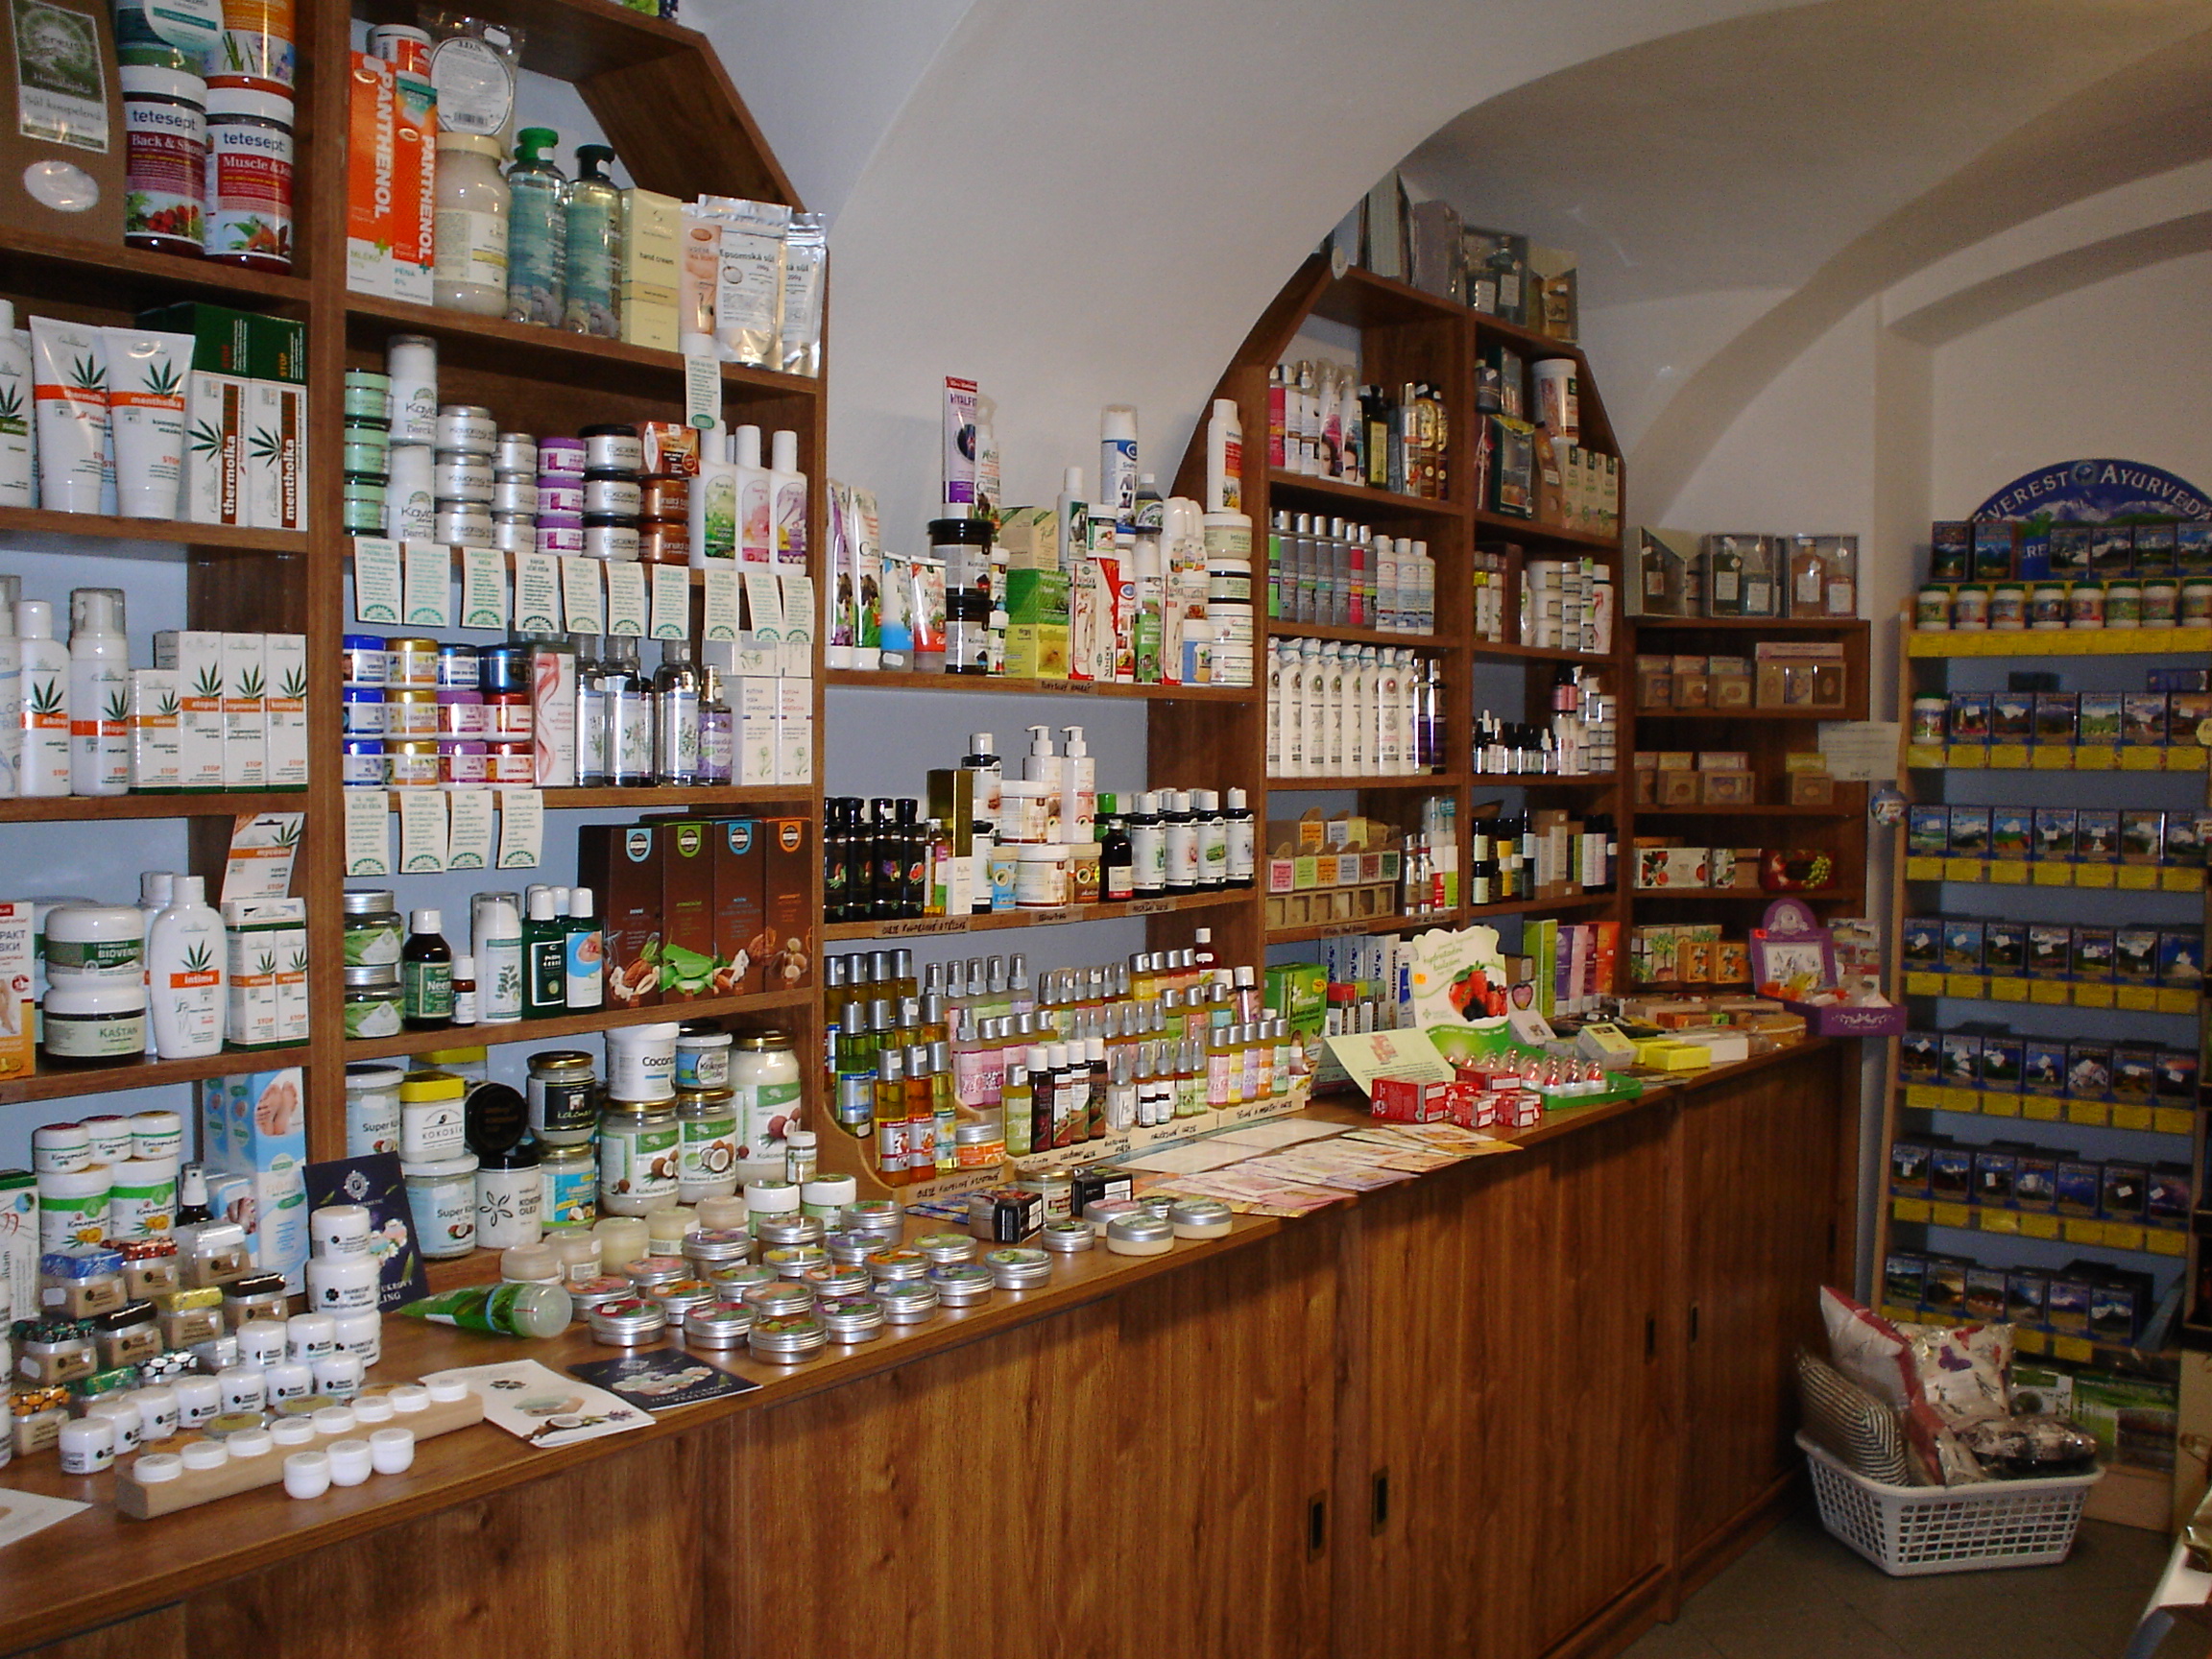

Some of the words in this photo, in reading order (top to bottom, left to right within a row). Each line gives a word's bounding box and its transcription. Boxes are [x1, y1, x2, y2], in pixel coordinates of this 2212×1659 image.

[223, 155, 268, 171] Muscle
[374, 71, 394, 219] PANTHENOL
[419, 133, 436, 259] PANTHENOL
[222, 435, 236, 516] thermolka
[283, 438, 295, 521] mentholka
[1973, 469, 2069, 523] EVEREST
